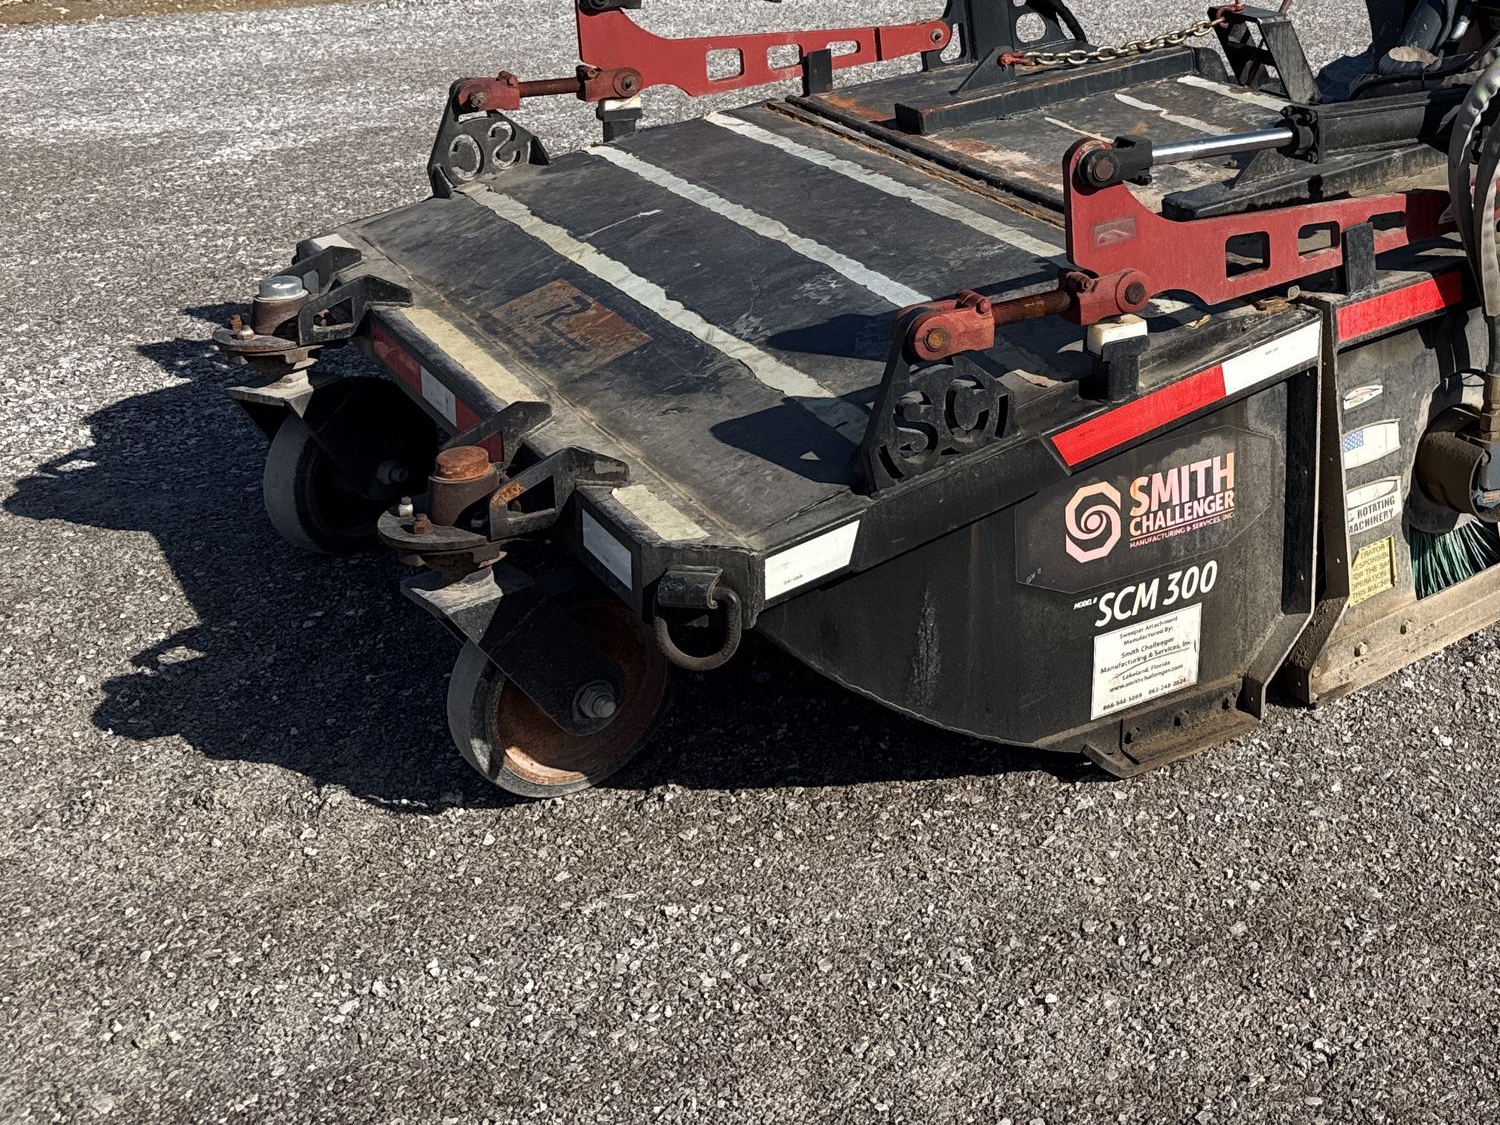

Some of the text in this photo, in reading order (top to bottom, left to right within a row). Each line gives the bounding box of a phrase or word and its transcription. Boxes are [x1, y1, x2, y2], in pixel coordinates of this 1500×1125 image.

[1129, 451, 1235, 517] SMITH
[1129, 490, 1235, 537] CHALLENGER
[1357, 495, 1396, 519] ROTATING
[1129, 527, 1186, 549] MANUFACTURING
[1095, 578, 1160, 627] SCM
[1162, 560, 1218, 606] 300
[1121, 637, 1175, 659] Smith Challenger
[1100, 654, 1148, 674] Manufacturing
